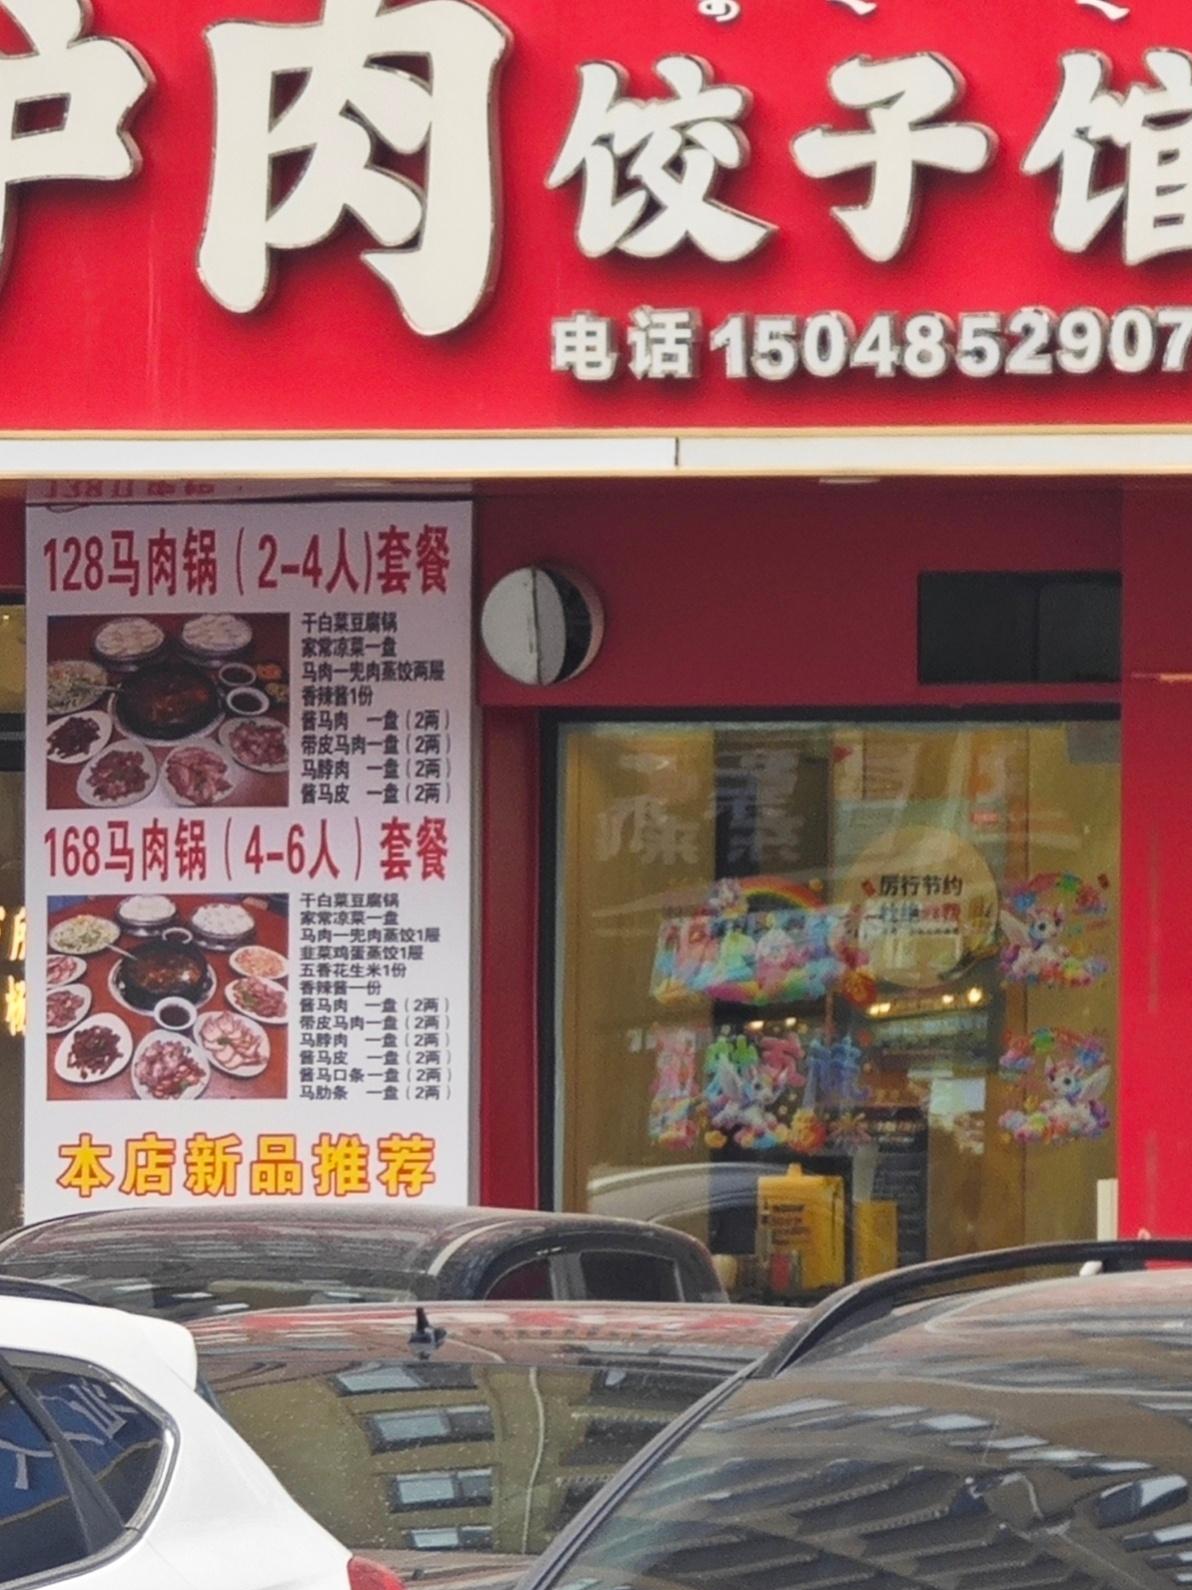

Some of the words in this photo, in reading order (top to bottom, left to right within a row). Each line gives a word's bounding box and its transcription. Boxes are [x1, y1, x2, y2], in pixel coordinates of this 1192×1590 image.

[302, 637, 397, 657] 家常凉菜一盘
[880, 874, 963, 896] 厉行节约
[300, 910, 398, 926] 家常凉菜一盘
[299, 963, 407, 978] 五香花生米1份
[57, 1132, 436, 1197] 本店新品推荐
